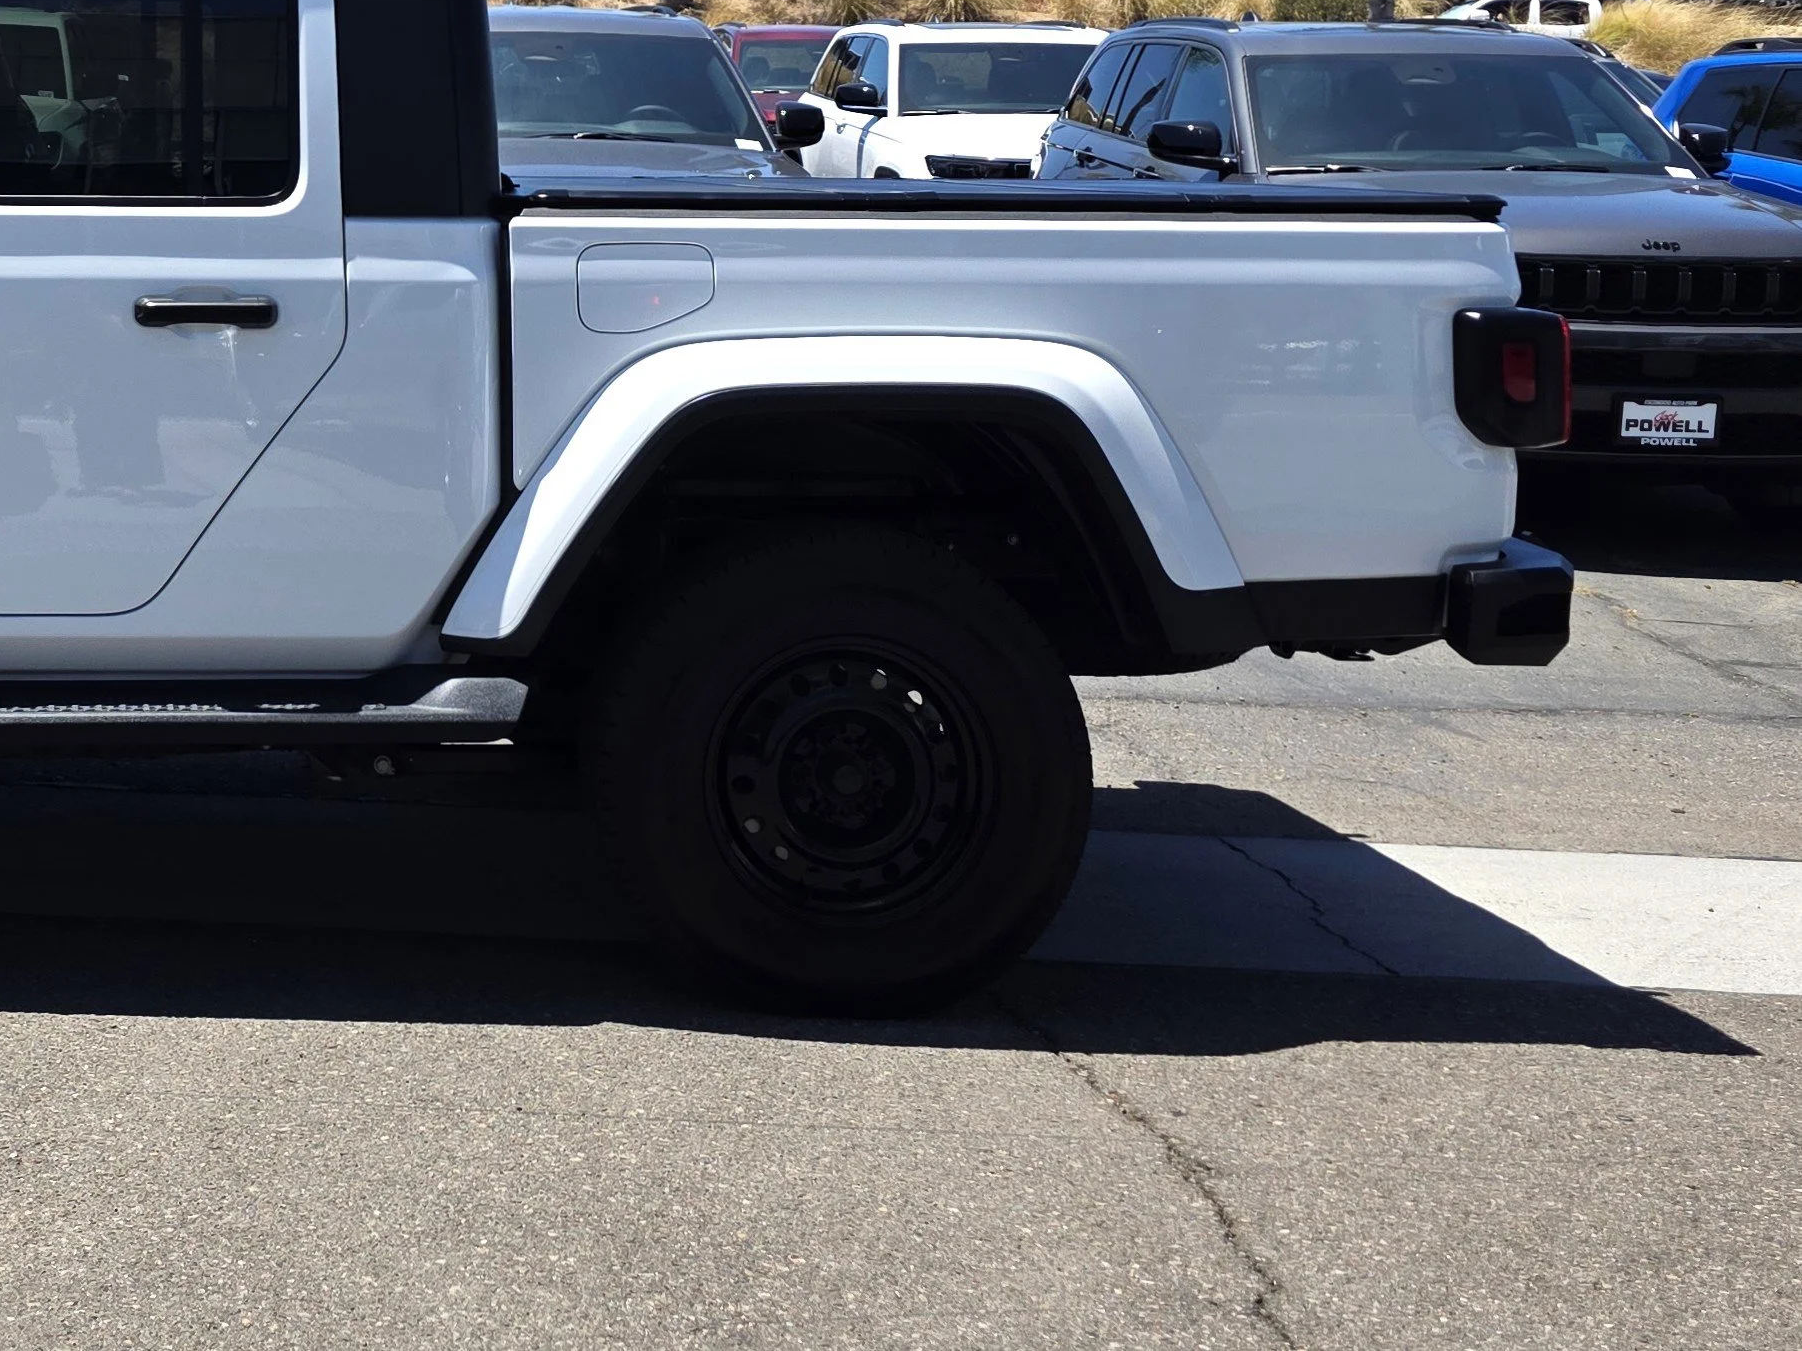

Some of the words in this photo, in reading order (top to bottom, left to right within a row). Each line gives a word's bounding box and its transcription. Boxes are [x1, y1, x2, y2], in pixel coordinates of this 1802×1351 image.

[1641, 238, 1681, 252] Jeep
[1625, 418, 1709, 433] POWELL
[1641, 438, 1697, 446] POWELL
